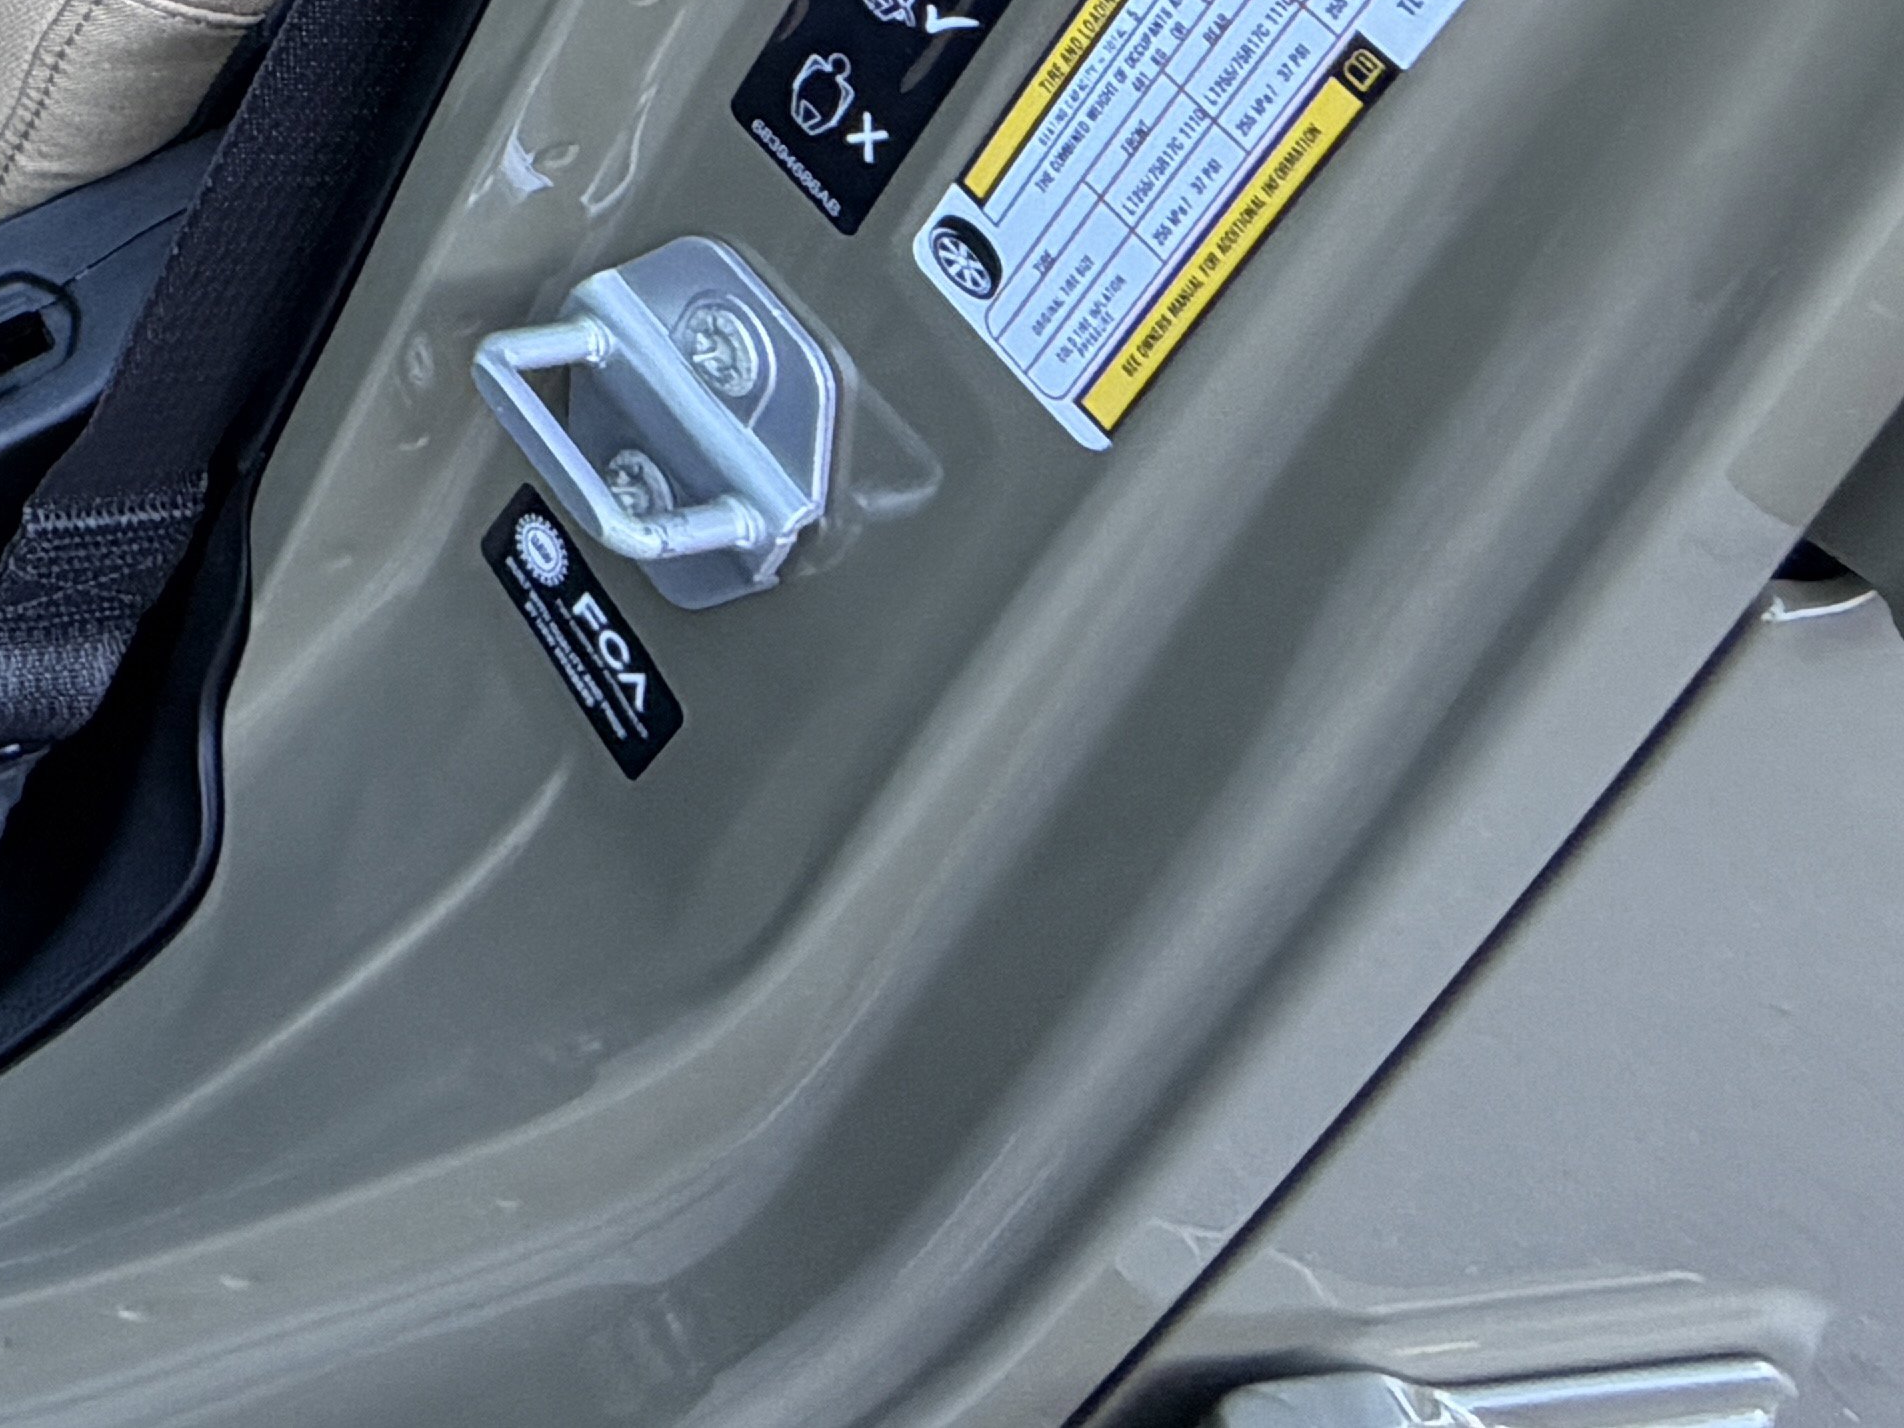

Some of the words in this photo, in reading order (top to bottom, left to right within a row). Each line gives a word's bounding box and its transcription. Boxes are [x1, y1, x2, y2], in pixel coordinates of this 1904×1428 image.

[1038, 60, 1067, 96] TIRE
[1058, 34, 1086, 68] AND
[569, 586, 660, 717] FCA
